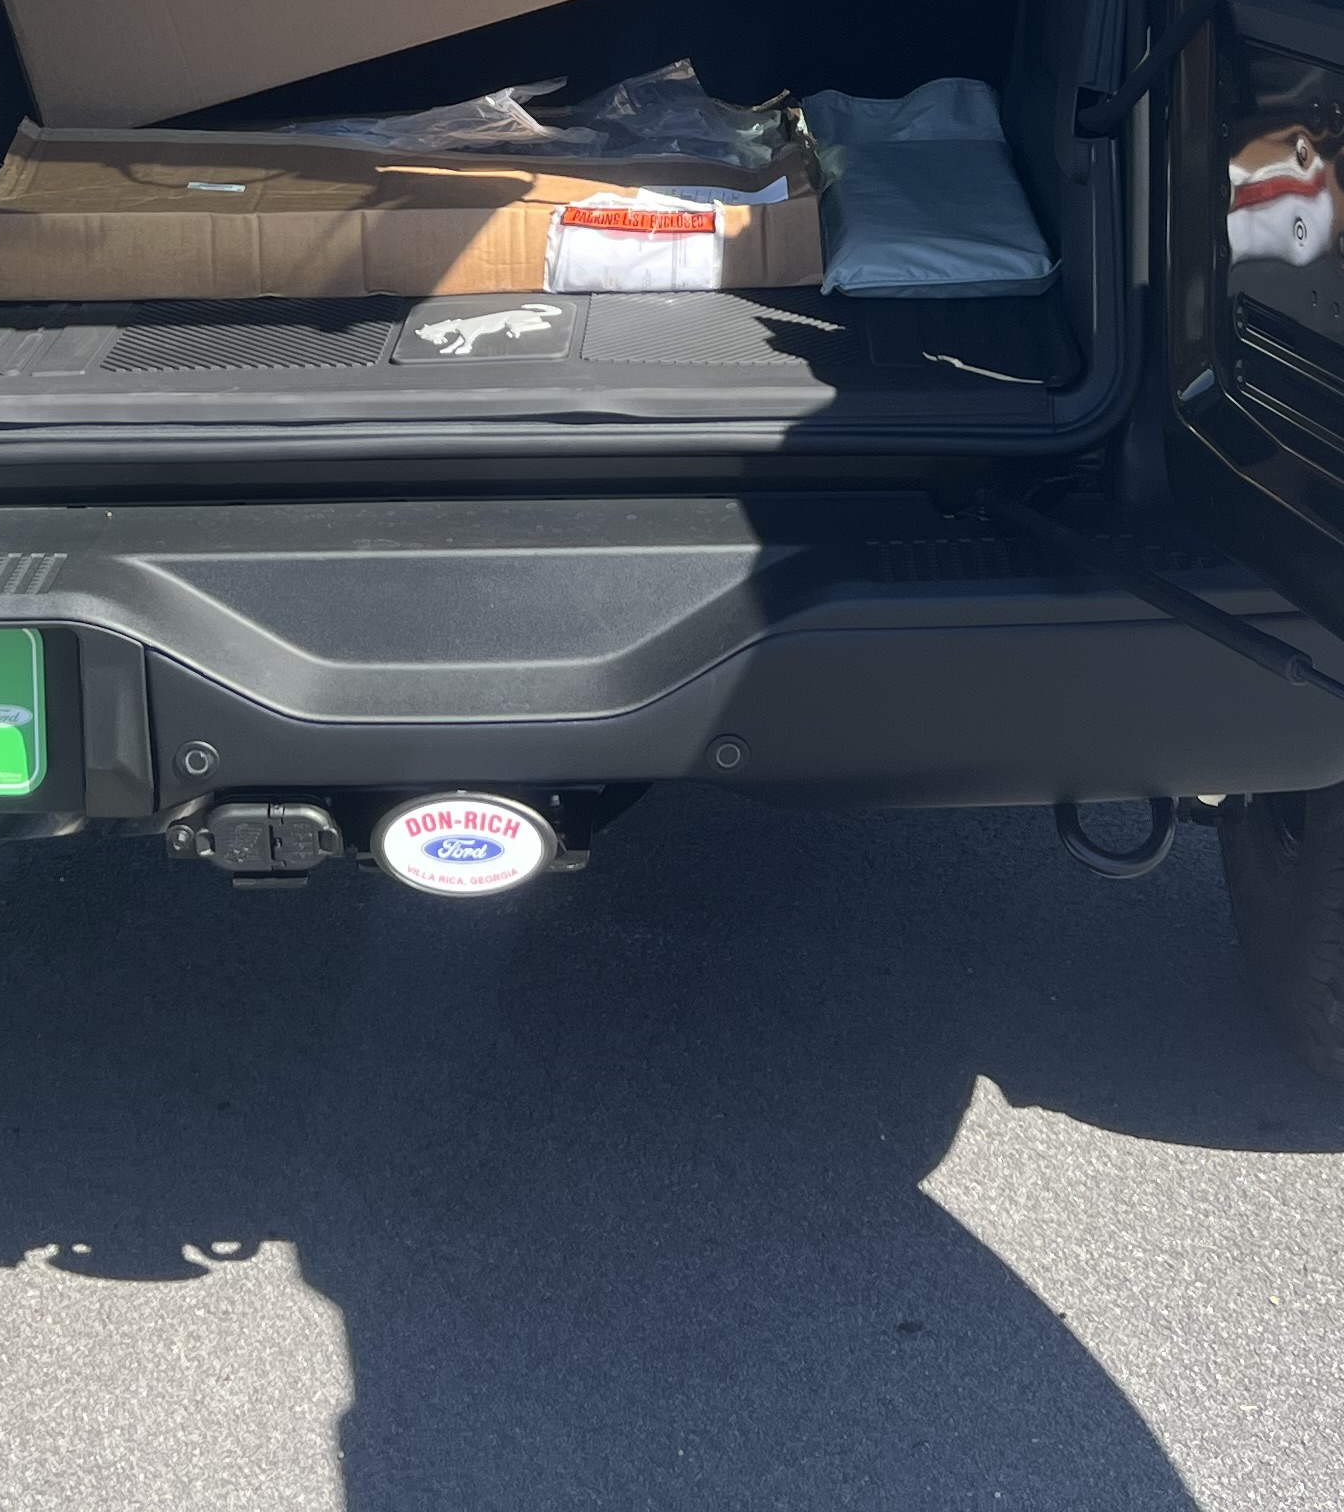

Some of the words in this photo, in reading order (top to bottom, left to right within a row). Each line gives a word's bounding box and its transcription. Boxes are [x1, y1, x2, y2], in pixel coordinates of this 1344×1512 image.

[572, 210, 621, 226] PACKING
[622, 212, 647, 228] LIST
[649, 213, 705, 229] ENCLOSED
[404, 810, 521, 839] DON-RICH
[437, 839, 488, 860] Ford
[407, 865, 436, 883] VILLA
[470, 867, 520, 886] GEORGIA
